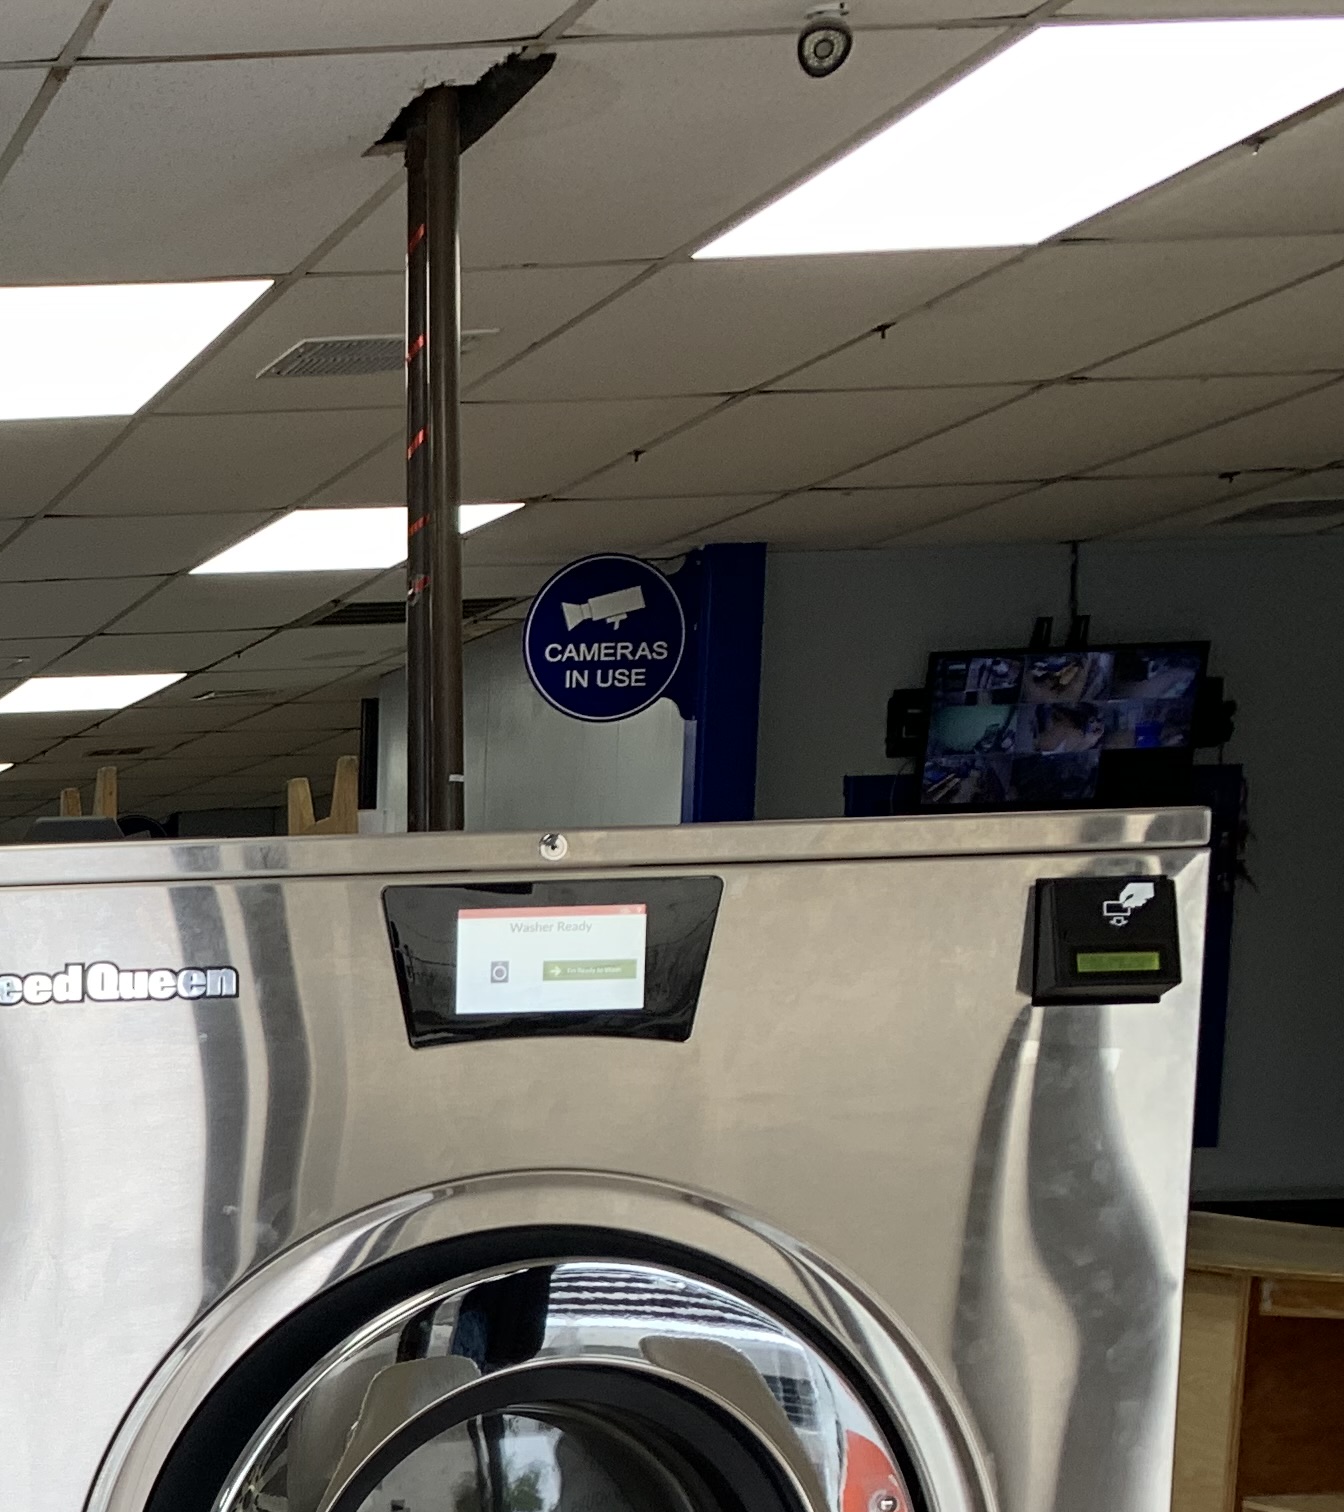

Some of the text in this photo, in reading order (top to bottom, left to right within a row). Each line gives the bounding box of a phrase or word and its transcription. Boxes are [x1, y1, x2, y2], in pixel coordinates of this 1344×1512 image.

[544, 641, 668, 662] CAMERAS
[564, 668, 647, 688] IN USE
[510, 920, 592, 933] Washer Ready
[85, 961, 239, 1003] Queen
